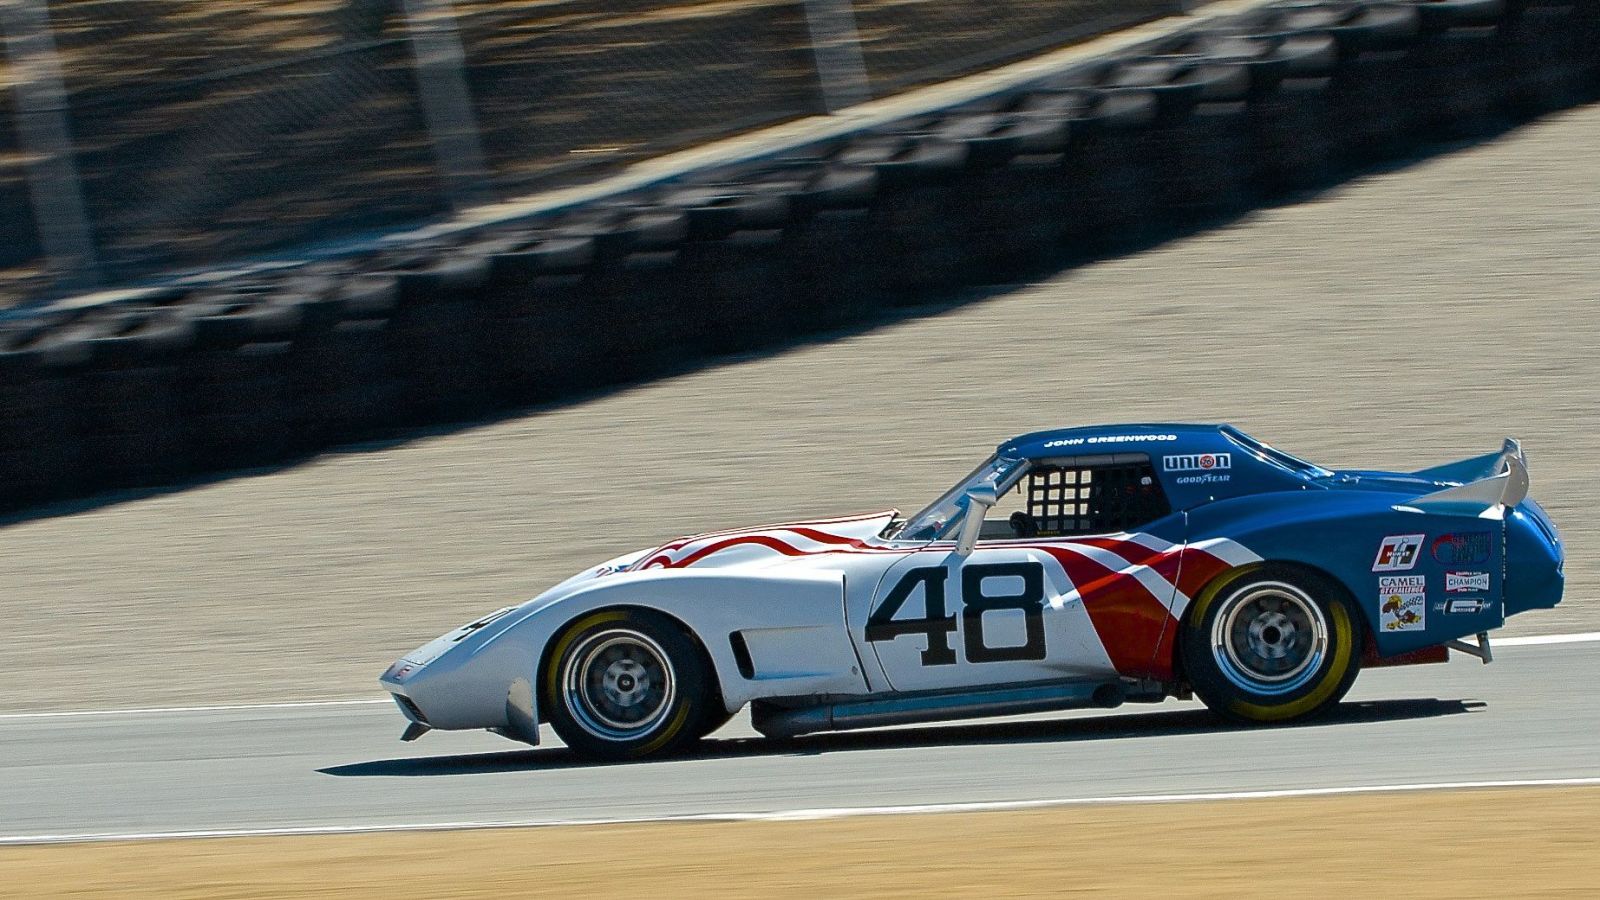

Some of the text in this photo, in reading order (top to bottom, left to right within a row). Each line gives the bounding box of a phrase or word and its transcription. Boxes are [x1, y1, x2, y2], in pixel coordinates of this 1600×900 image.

[1044, 434, 1177, 448] JOHN GREENWOOD
[1177, 474, 1230, 484] GOODYEAR
[1381, 577, 1423, 587] CAMEL
[1449, 577, 1487, 586] CHAMPION
[865, 562, 1047, 666] 48
